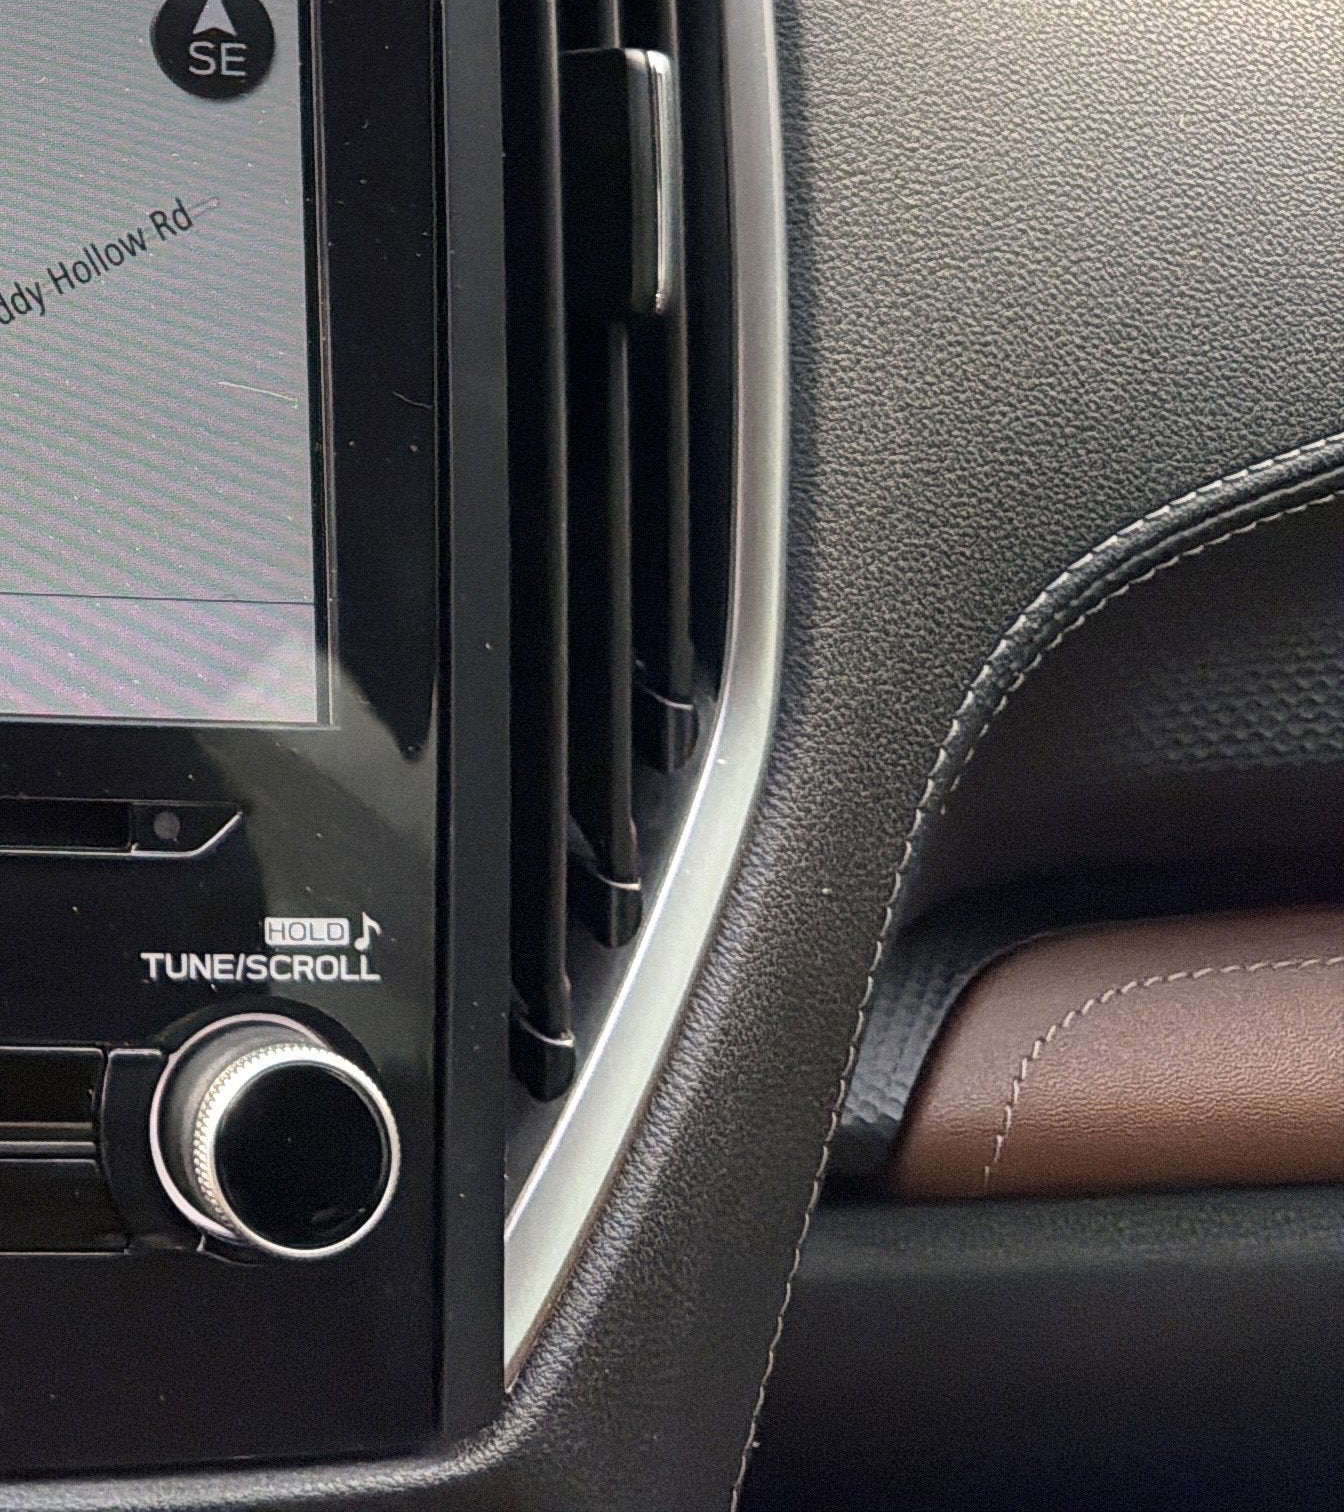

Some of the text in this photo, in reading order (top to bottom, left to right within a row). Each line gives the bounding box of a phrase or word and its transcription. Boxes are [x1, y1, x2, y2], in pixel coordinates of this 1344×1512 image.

[188, 40, 248, 77] SE
[46, 226, 148, 295] Hollow
[148, 196, 194, 241] Rd
[267, 920, 346, 943] HOLD
[140, 952, 382, 982] TUNE/SCROLL
